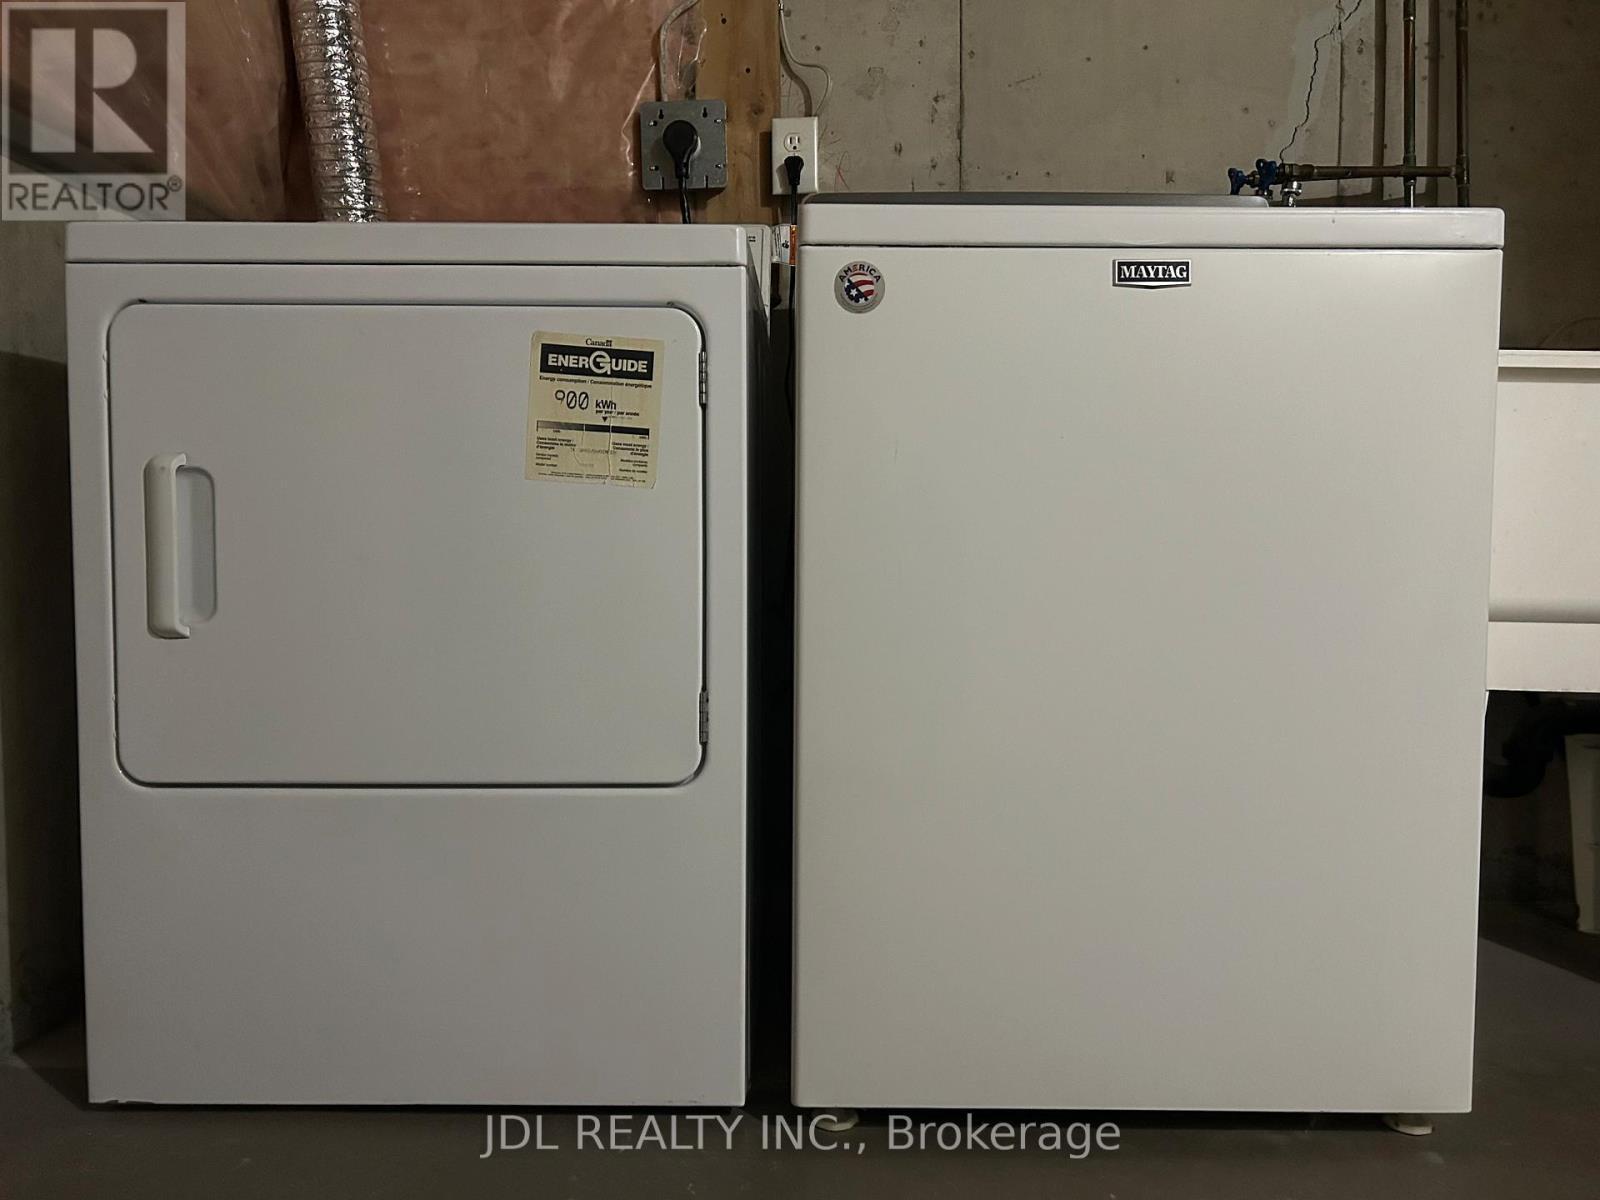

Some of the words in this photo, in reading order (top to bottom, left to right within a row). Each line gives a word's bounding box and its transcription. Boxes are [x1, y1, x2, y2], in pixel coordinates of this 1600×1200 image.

[839, 264, 881, 282] AMERICA
[1120, 265, 1187, 278] MAYTAG
[547, 350, 648, 375] ENERGUIDE
[554, 389, 589, 410] 900
[595, 399, 616, 410] kWh
